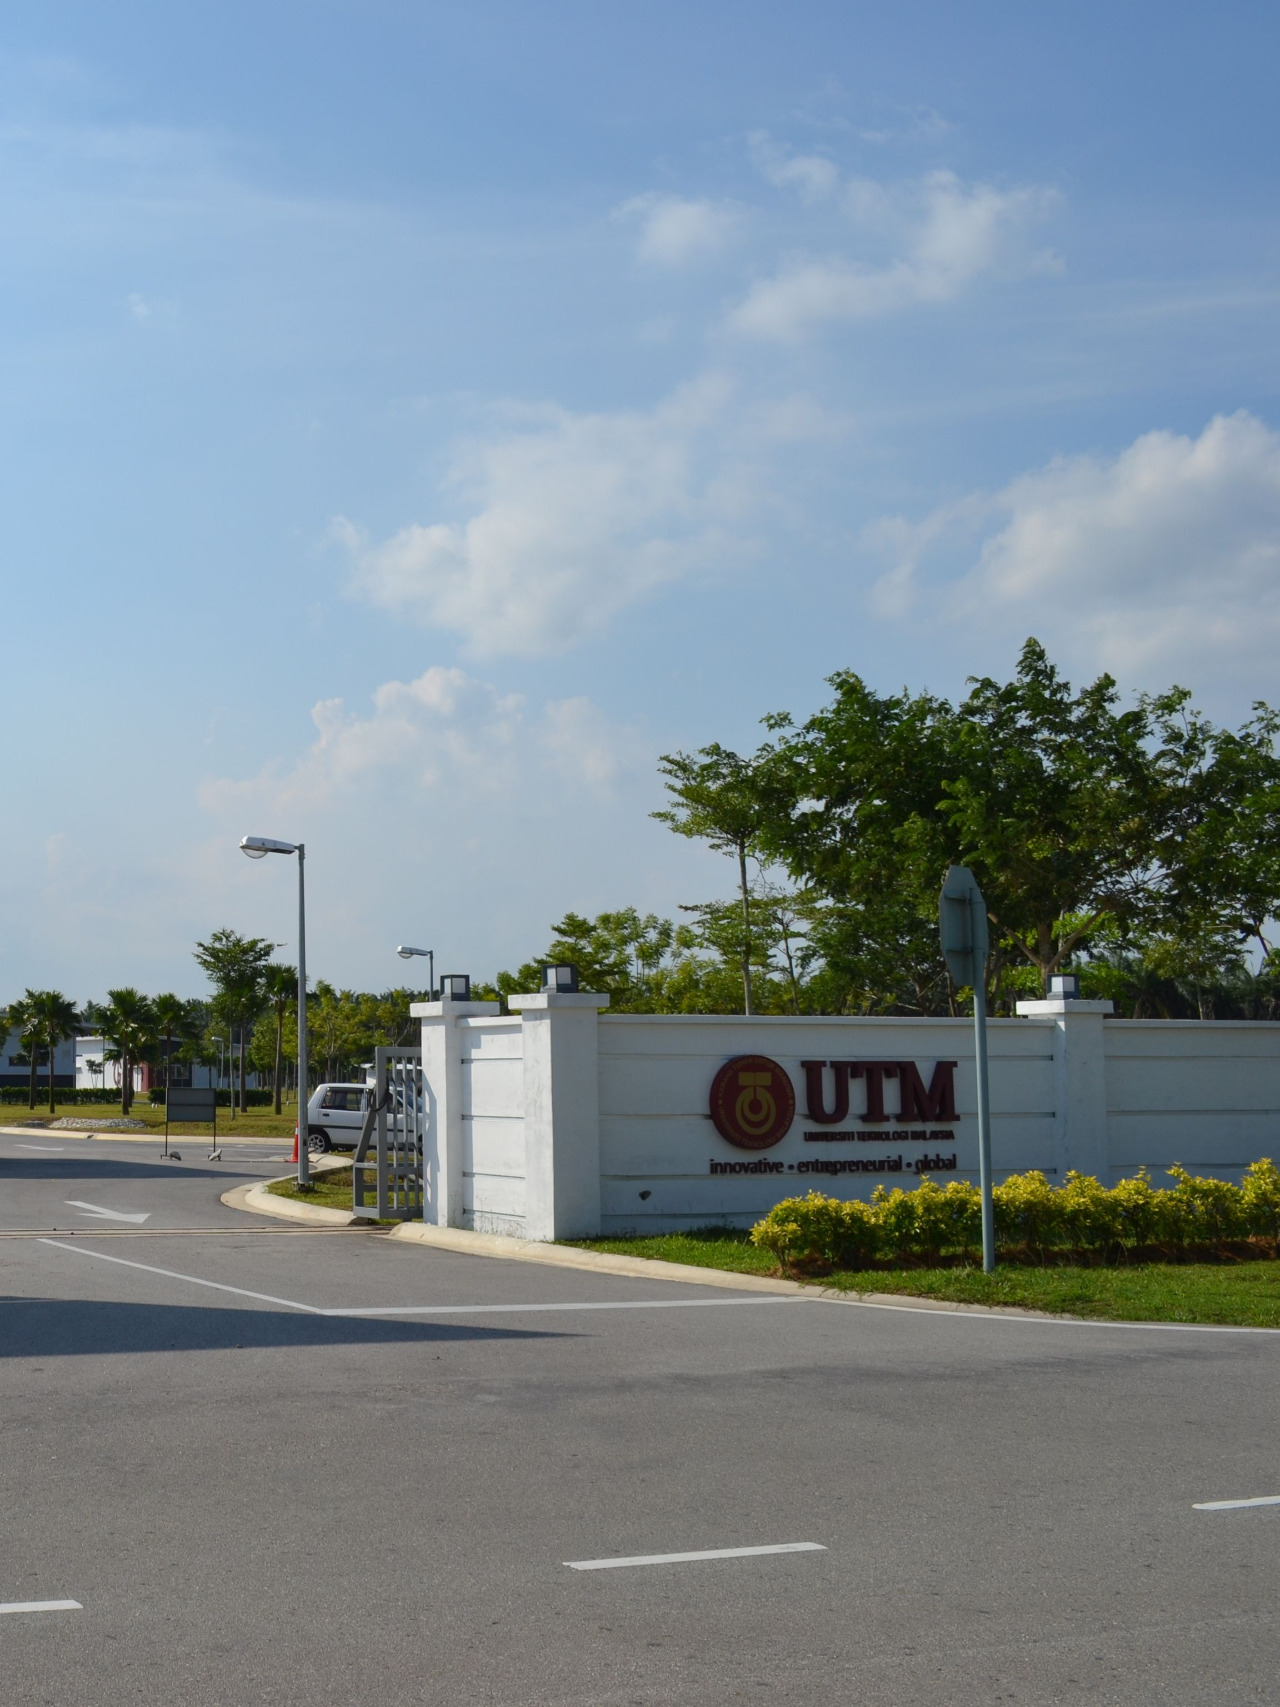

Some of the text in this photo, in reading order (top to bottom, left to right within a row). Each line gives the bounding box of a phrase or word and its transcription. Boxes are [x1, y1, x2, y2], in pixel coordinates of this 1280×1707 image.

[800, 1060, 961, 1124] UTM
[804, 1130, 955, 1142] UNIVERSITI TEKNOLOGI MALAYSIA
[710, 1154, 957, 1175] innovative entrepreneurial global
